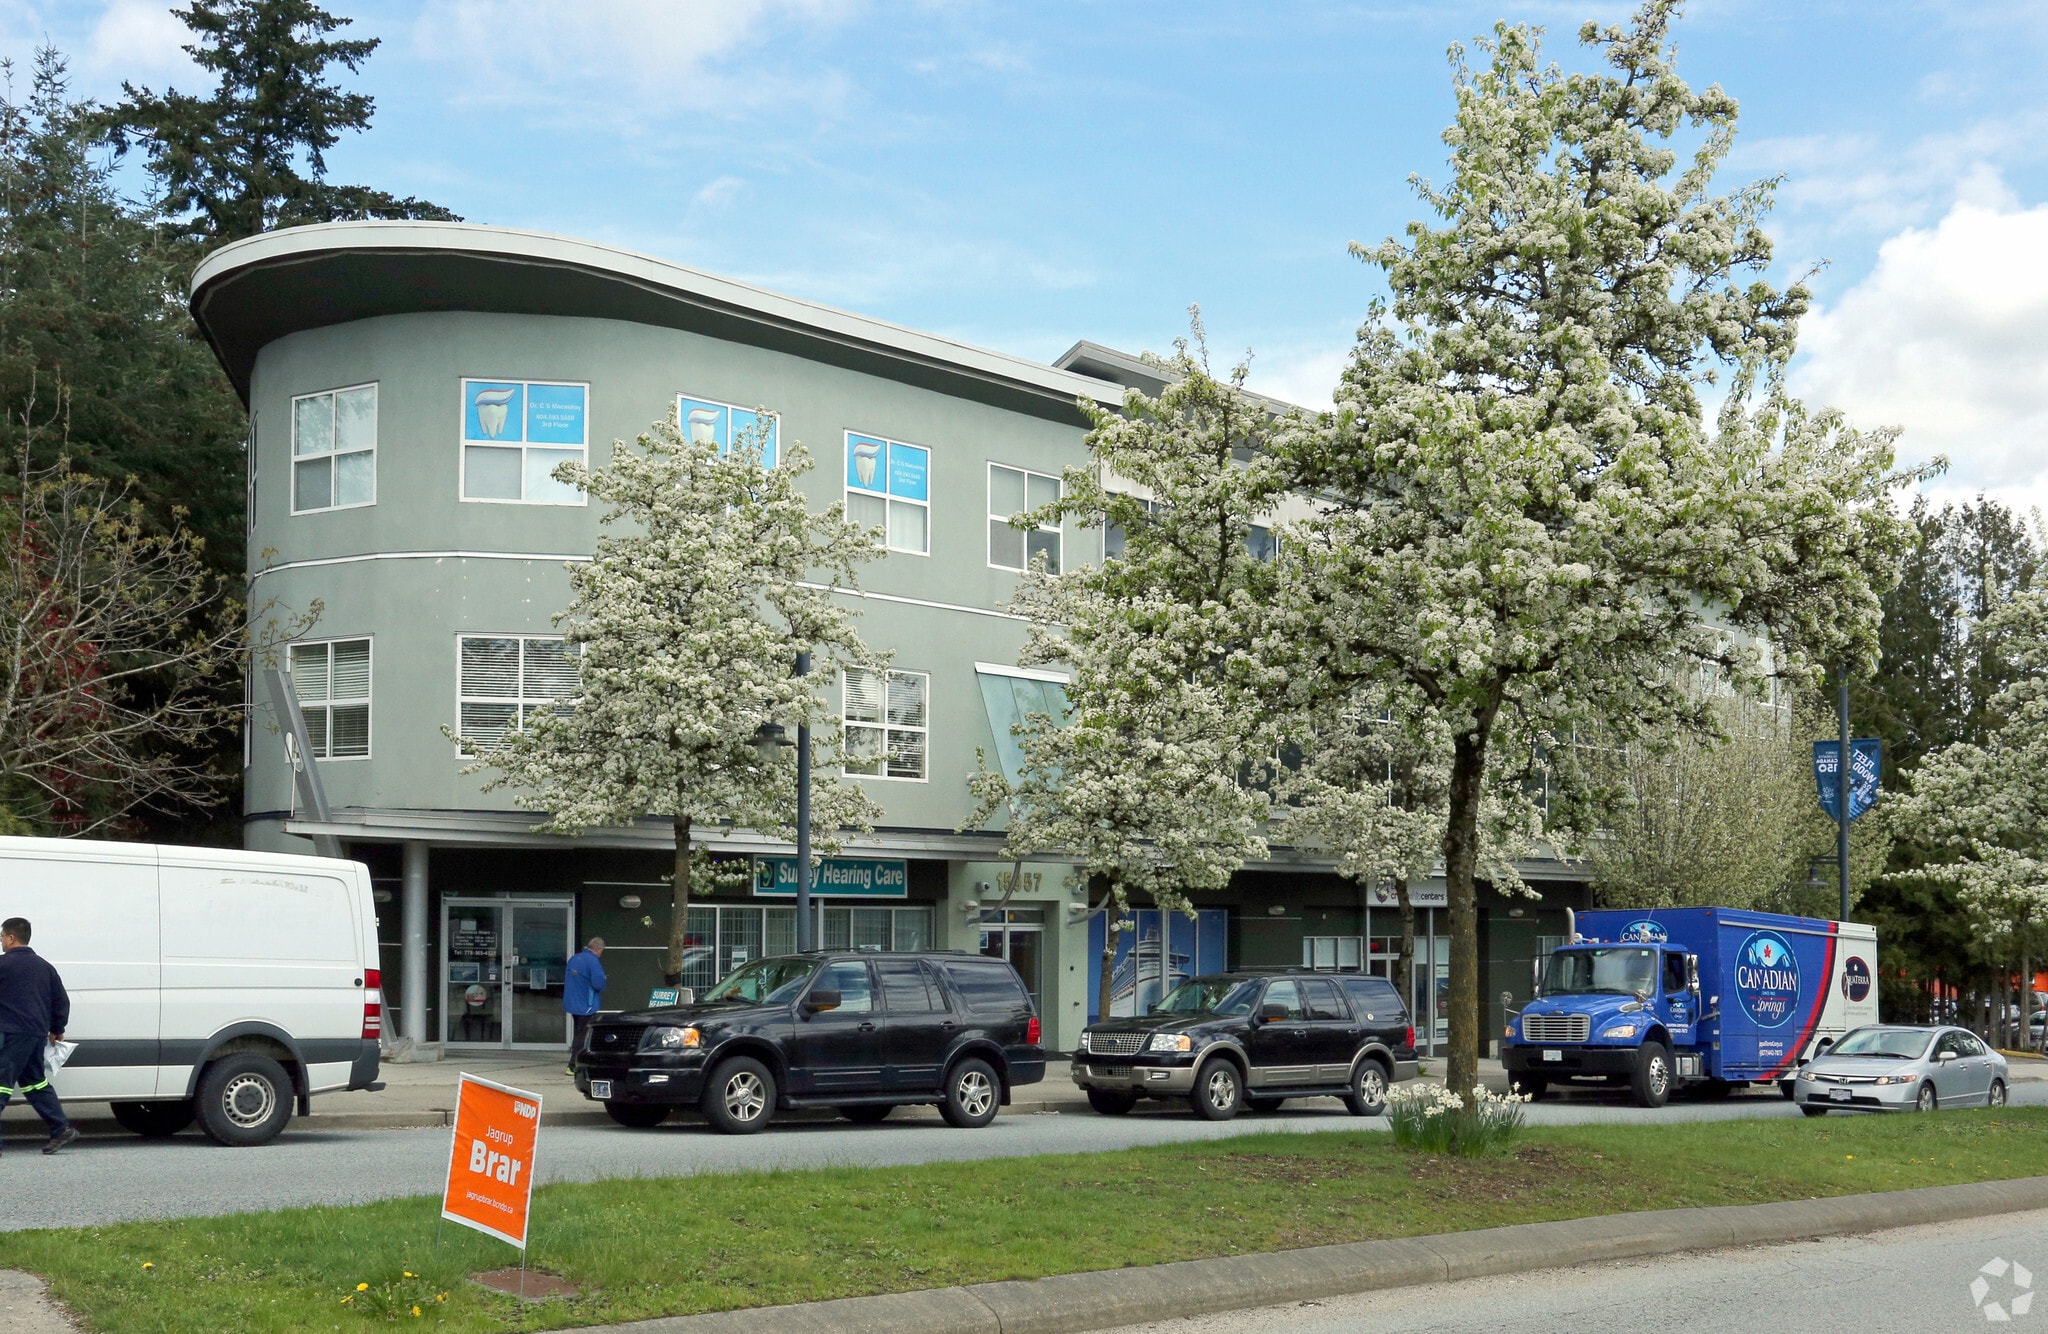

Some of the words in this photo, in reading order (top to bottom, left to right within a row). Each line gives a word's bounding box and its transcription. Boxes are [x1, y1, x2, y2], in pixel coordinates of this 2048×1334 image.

[823, 864, 872, 889] Hearing
[875, 864, 903, 885] Care
[1738, 966, 1797, 991] CANADIAN
[652, 990, 676, 1000] SURREY
[485, 1125, 514, 1147] Jagrup
[469, 1139, 521, 1186] Brar
